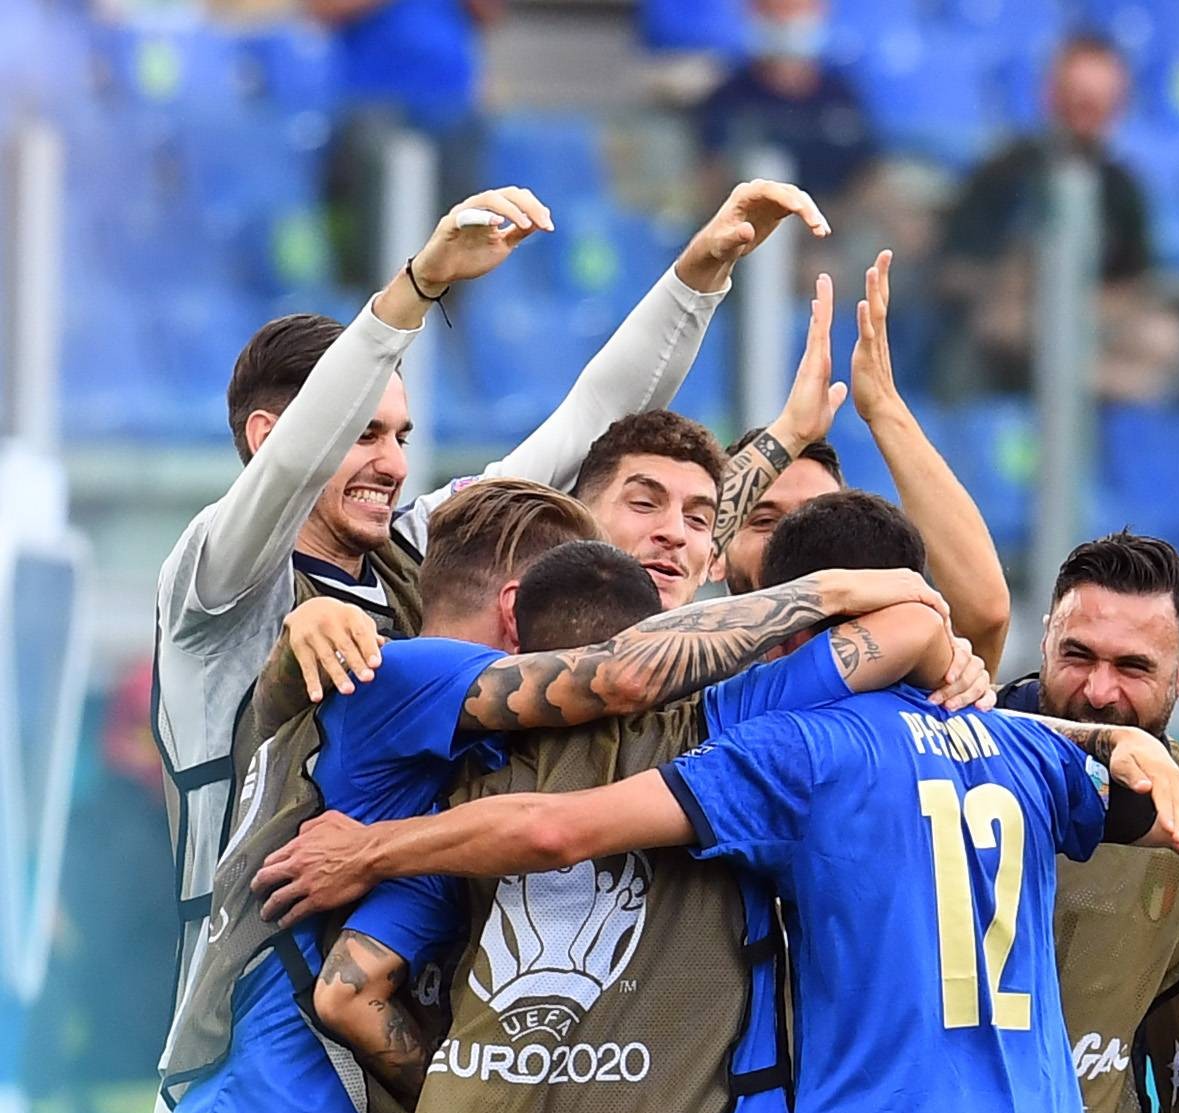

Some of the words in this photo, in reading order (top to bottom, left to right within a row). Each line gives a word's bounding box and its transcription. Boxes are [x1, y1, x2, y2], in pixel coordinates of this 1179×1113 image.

[917, 779, 1031, 1031] 12
[501, 1009, 575, 1037] UEFA
[427, 1039, 651, 1085] EURO2020
